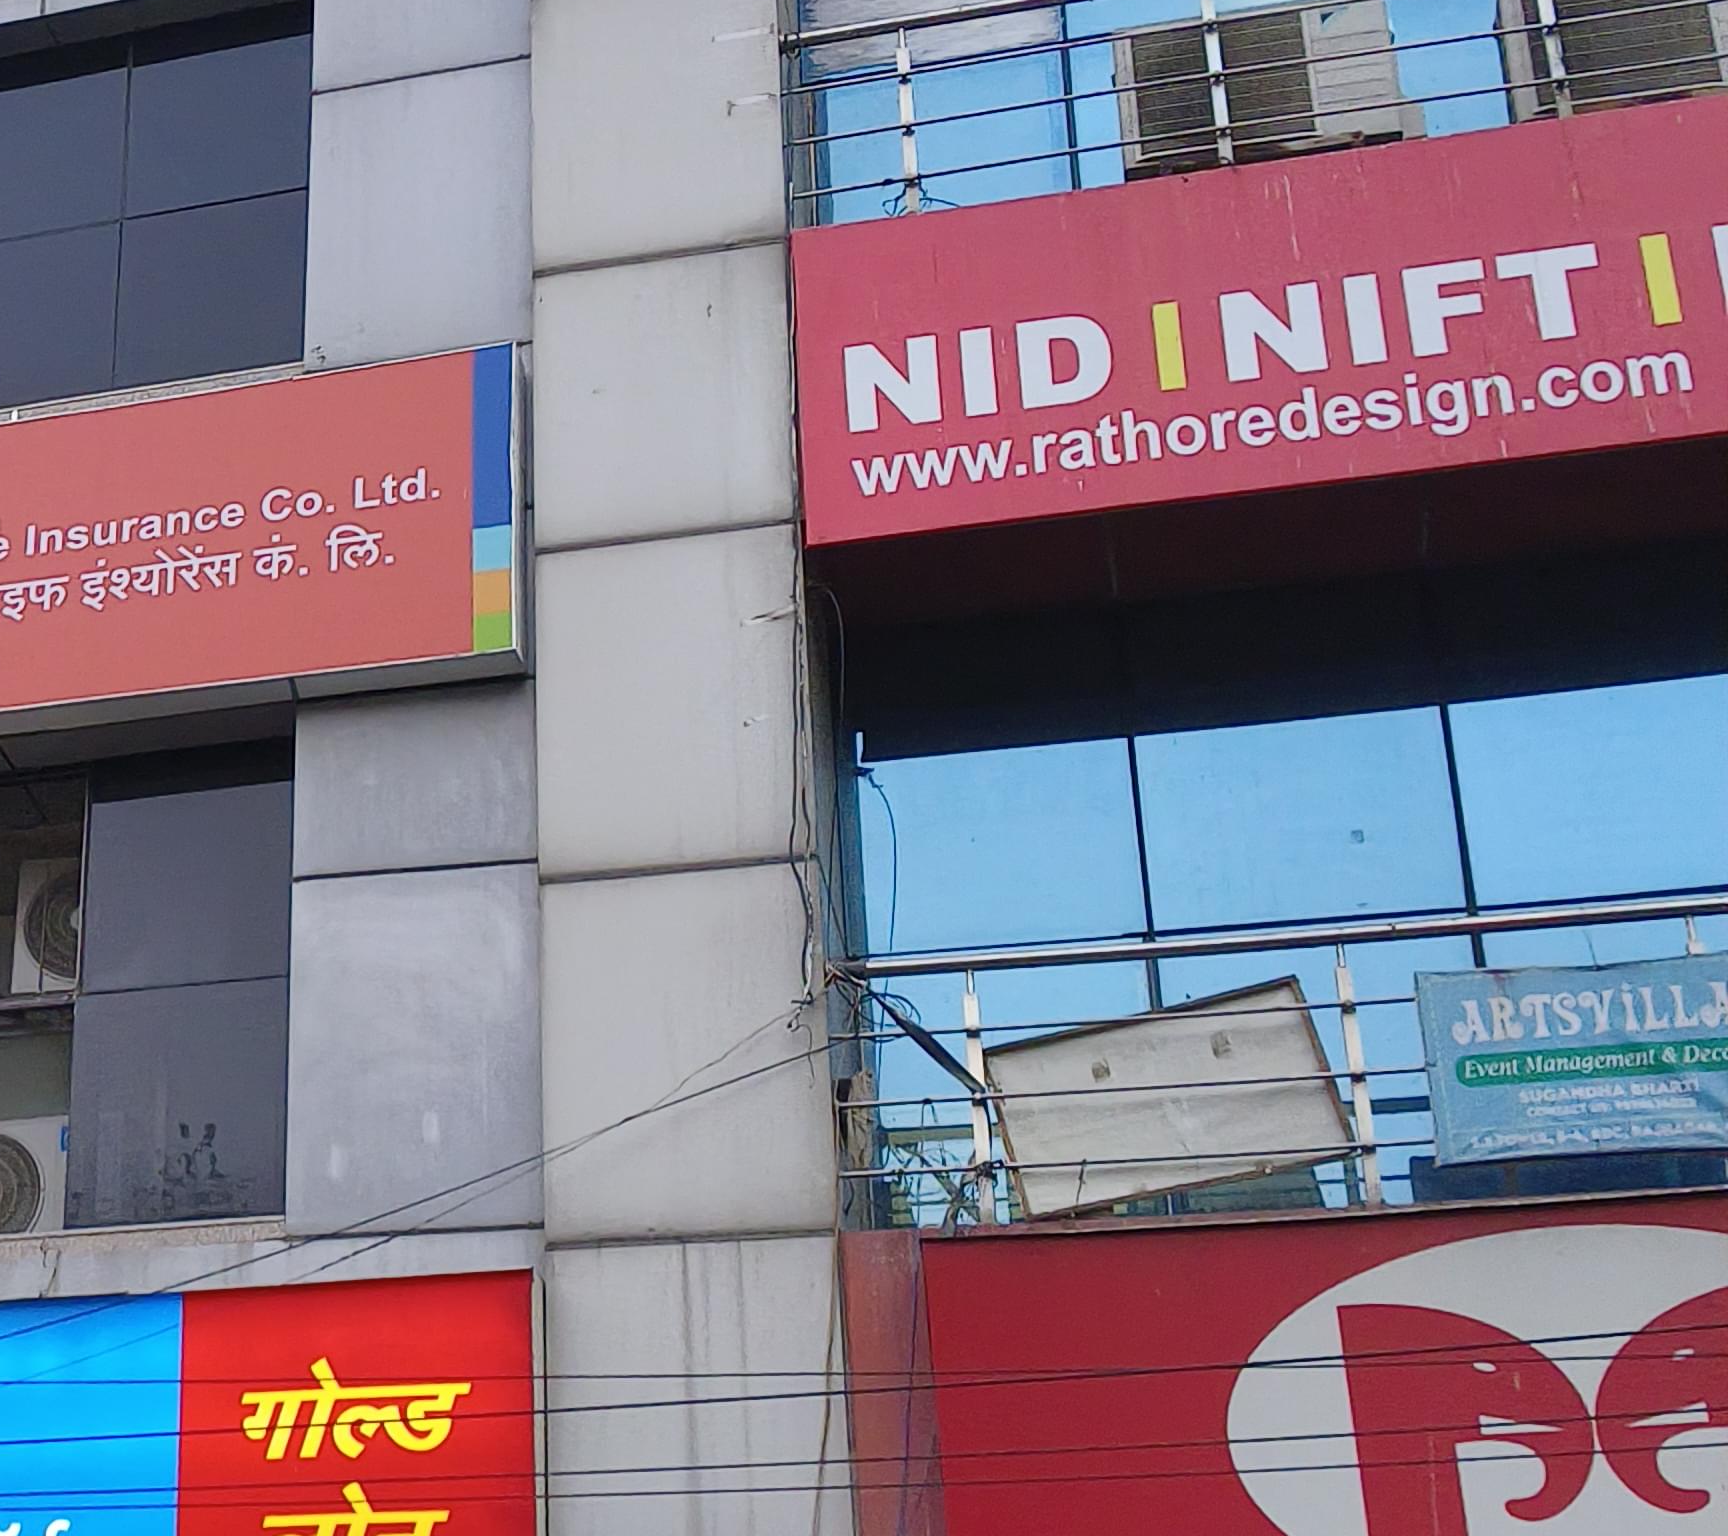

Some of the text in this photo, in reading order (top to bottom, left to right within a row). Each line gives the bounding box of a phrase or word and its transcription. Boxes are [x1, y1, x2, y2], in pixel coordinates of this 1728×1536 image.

[842, 242, 1599, 434] NID NIFT
[851, 350, 1695, 498] www.rathoredesign.com
[23, 501, 246, 557] Insurance
[260, 487, 336, 522] Co.
[353, 467, 442, 510] Ltd.
[80, 545, 243, 612] इंश्योरेंस
[252, 533, 310, 581] कं.
[324, 524, 396, 572] लि.
[1463, 1054, 1519, 1079] Event
[1526, 1049, 1655, 1075] Management
[1661, 1046, 1675, 1063] &
[240, 1356, 472, 1462] गोल्ड
